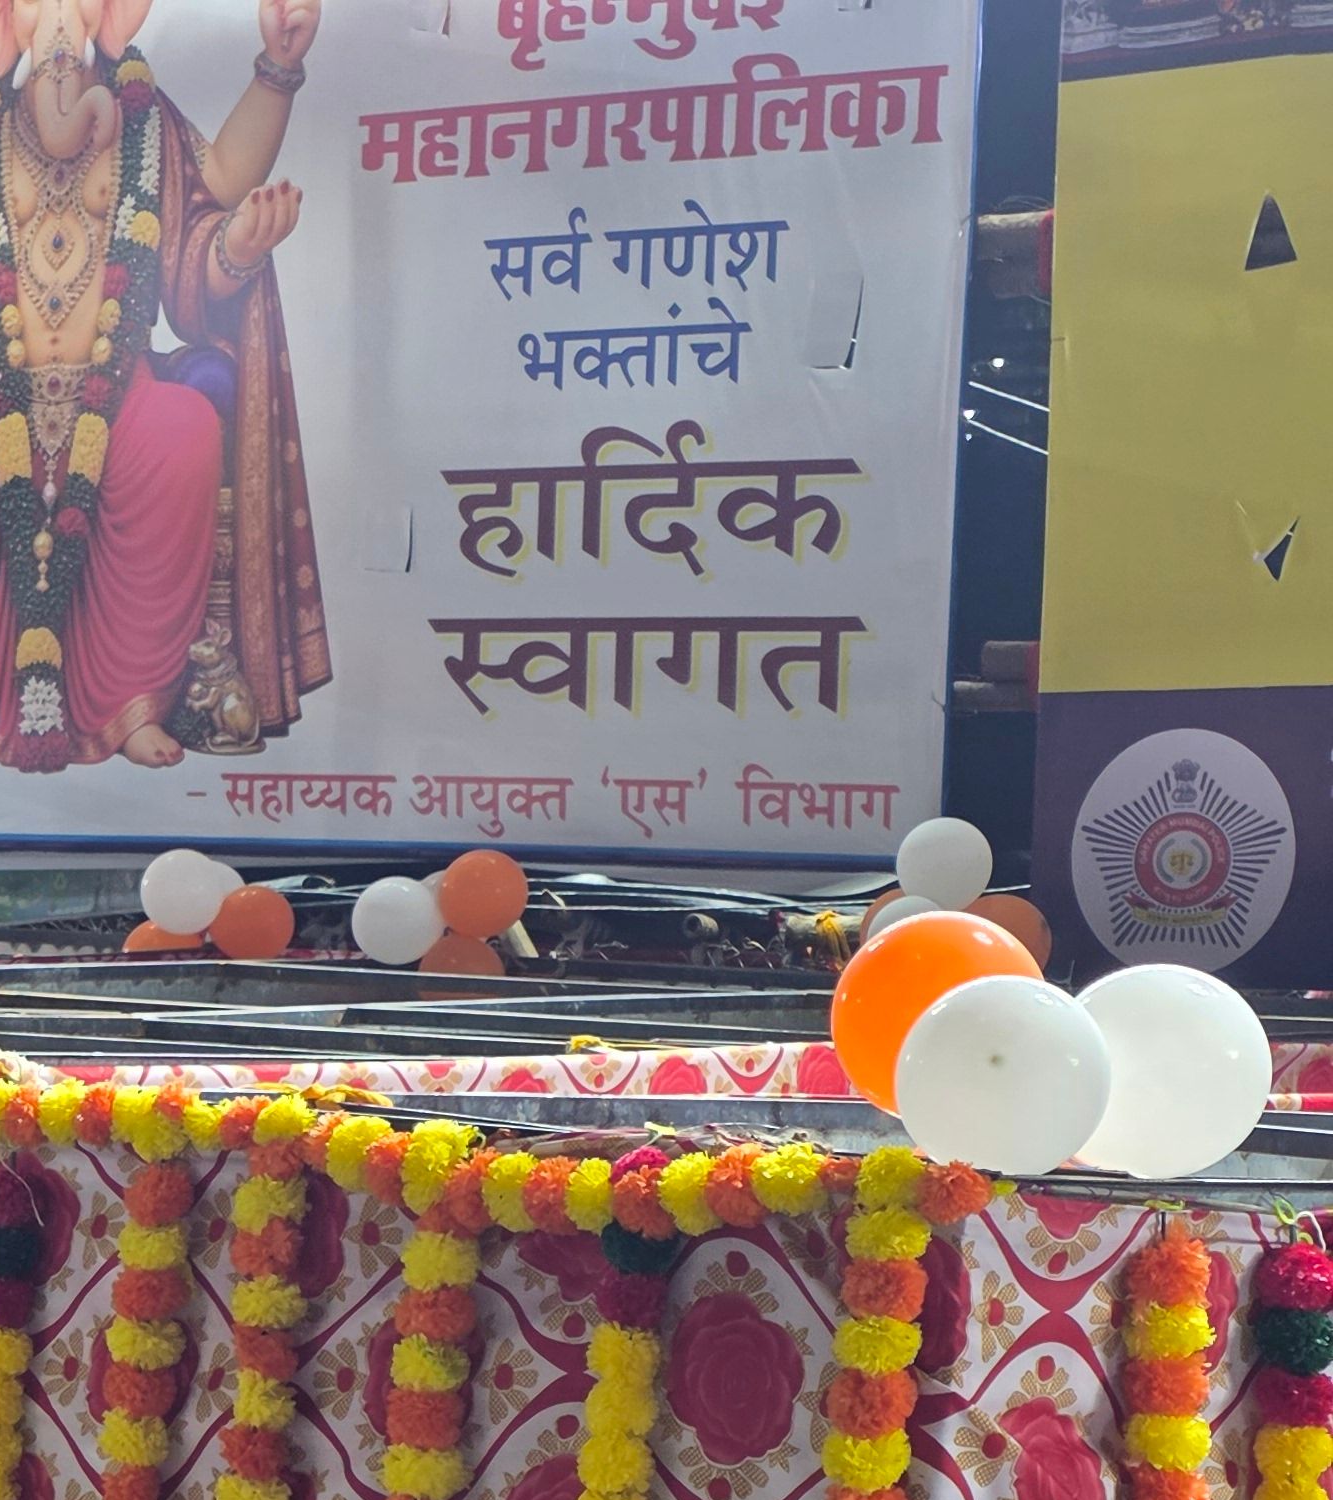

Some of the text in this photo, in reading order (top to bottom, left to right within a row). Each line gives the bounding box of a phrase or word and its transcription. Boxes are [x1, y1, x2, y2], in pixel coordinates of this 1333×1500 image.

[359, 53, 949, 184] महानगरपालिका
[484, 199, 790, 300] सर्व गणेश
[518, 297, 752, 390] भक्तांचे
[441, 419, 868, 580] हार्दिक
[428, 615, 866, 720] स्वागत
[409, 774, 573, 837] आयुक्त
[735, 764, 900, 830] विभाग
